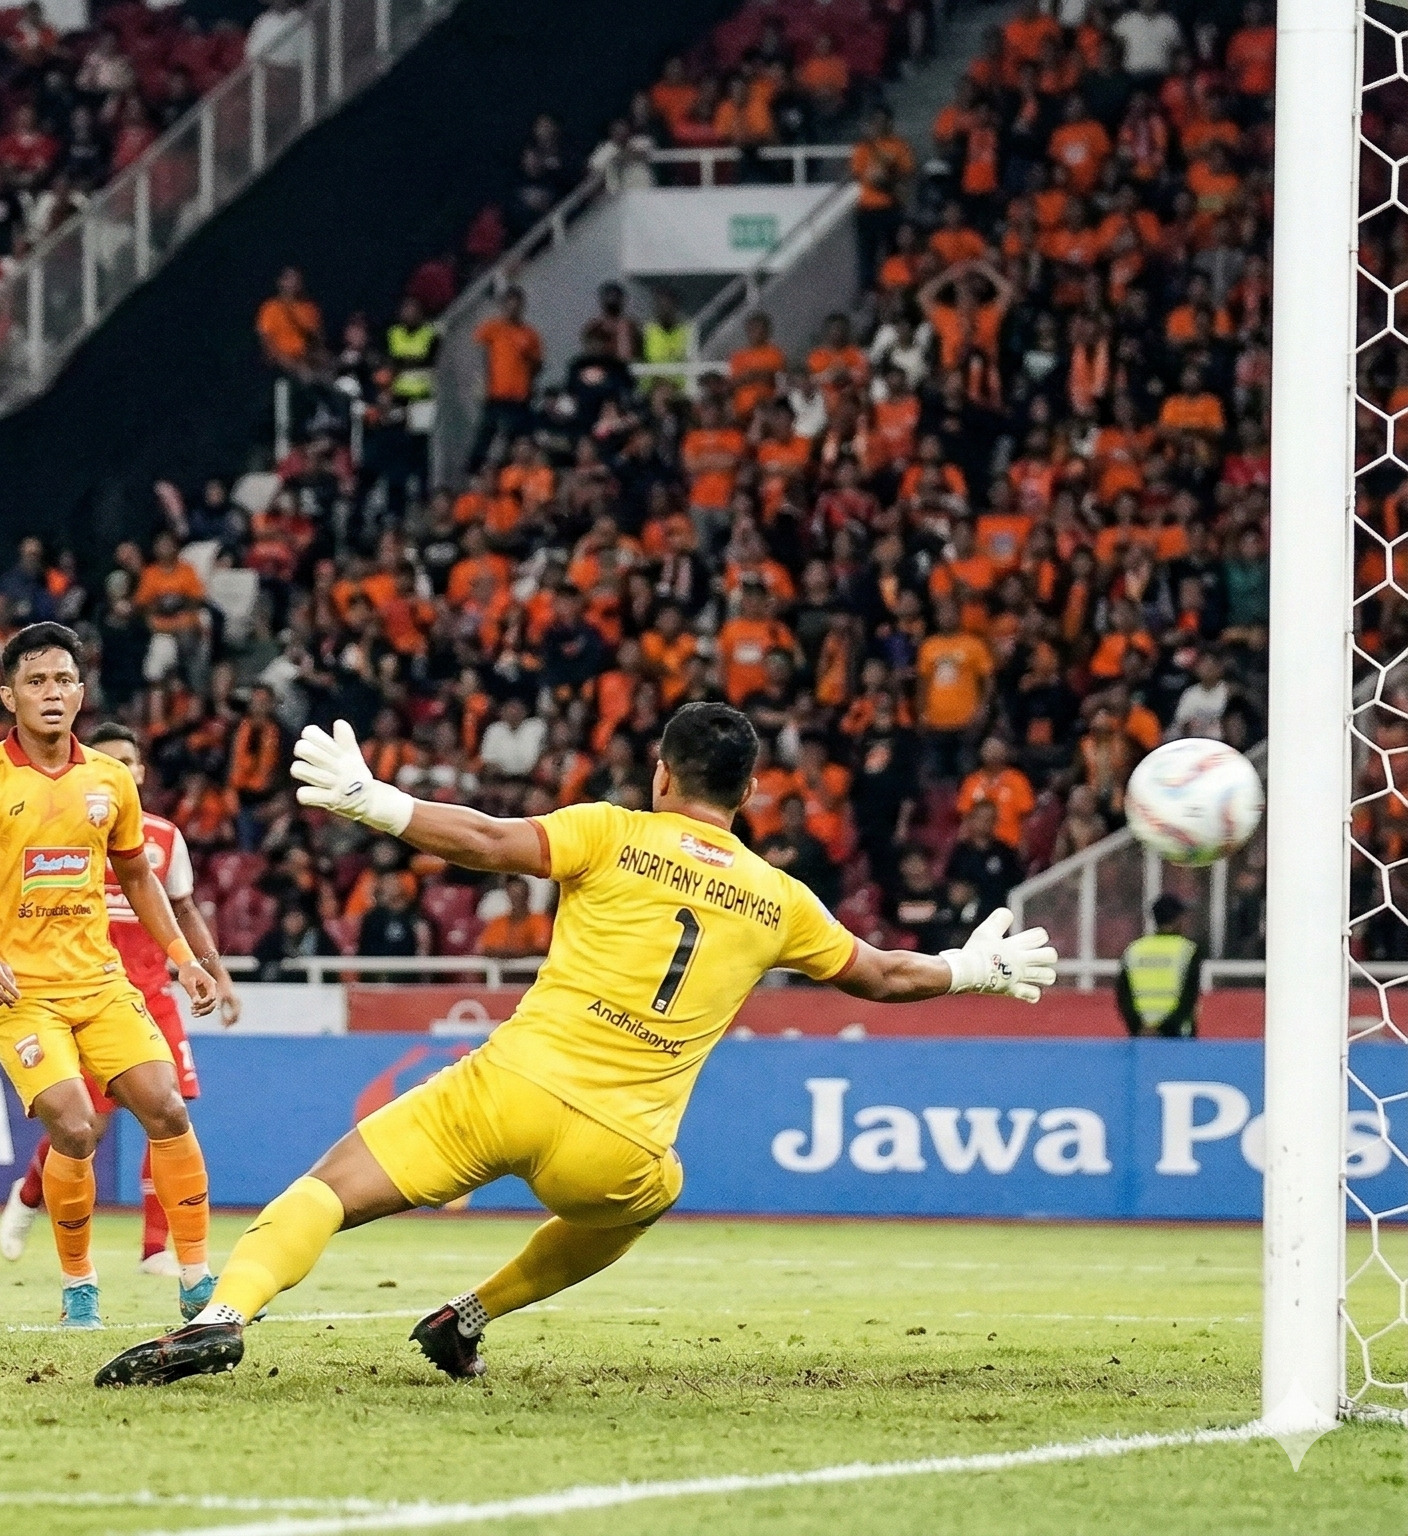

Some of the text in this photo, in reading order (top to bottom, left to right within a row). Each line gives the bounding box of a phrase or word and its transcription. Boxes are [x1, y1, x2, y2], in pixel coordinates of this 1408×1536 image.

[617, 844, 704, 897] ANDRITANY
[704, 878, 782, 931] ARDHIYASA
[651, 906, 704, 1016] 1
[771, 1077, 1113, 1175] Jawa
